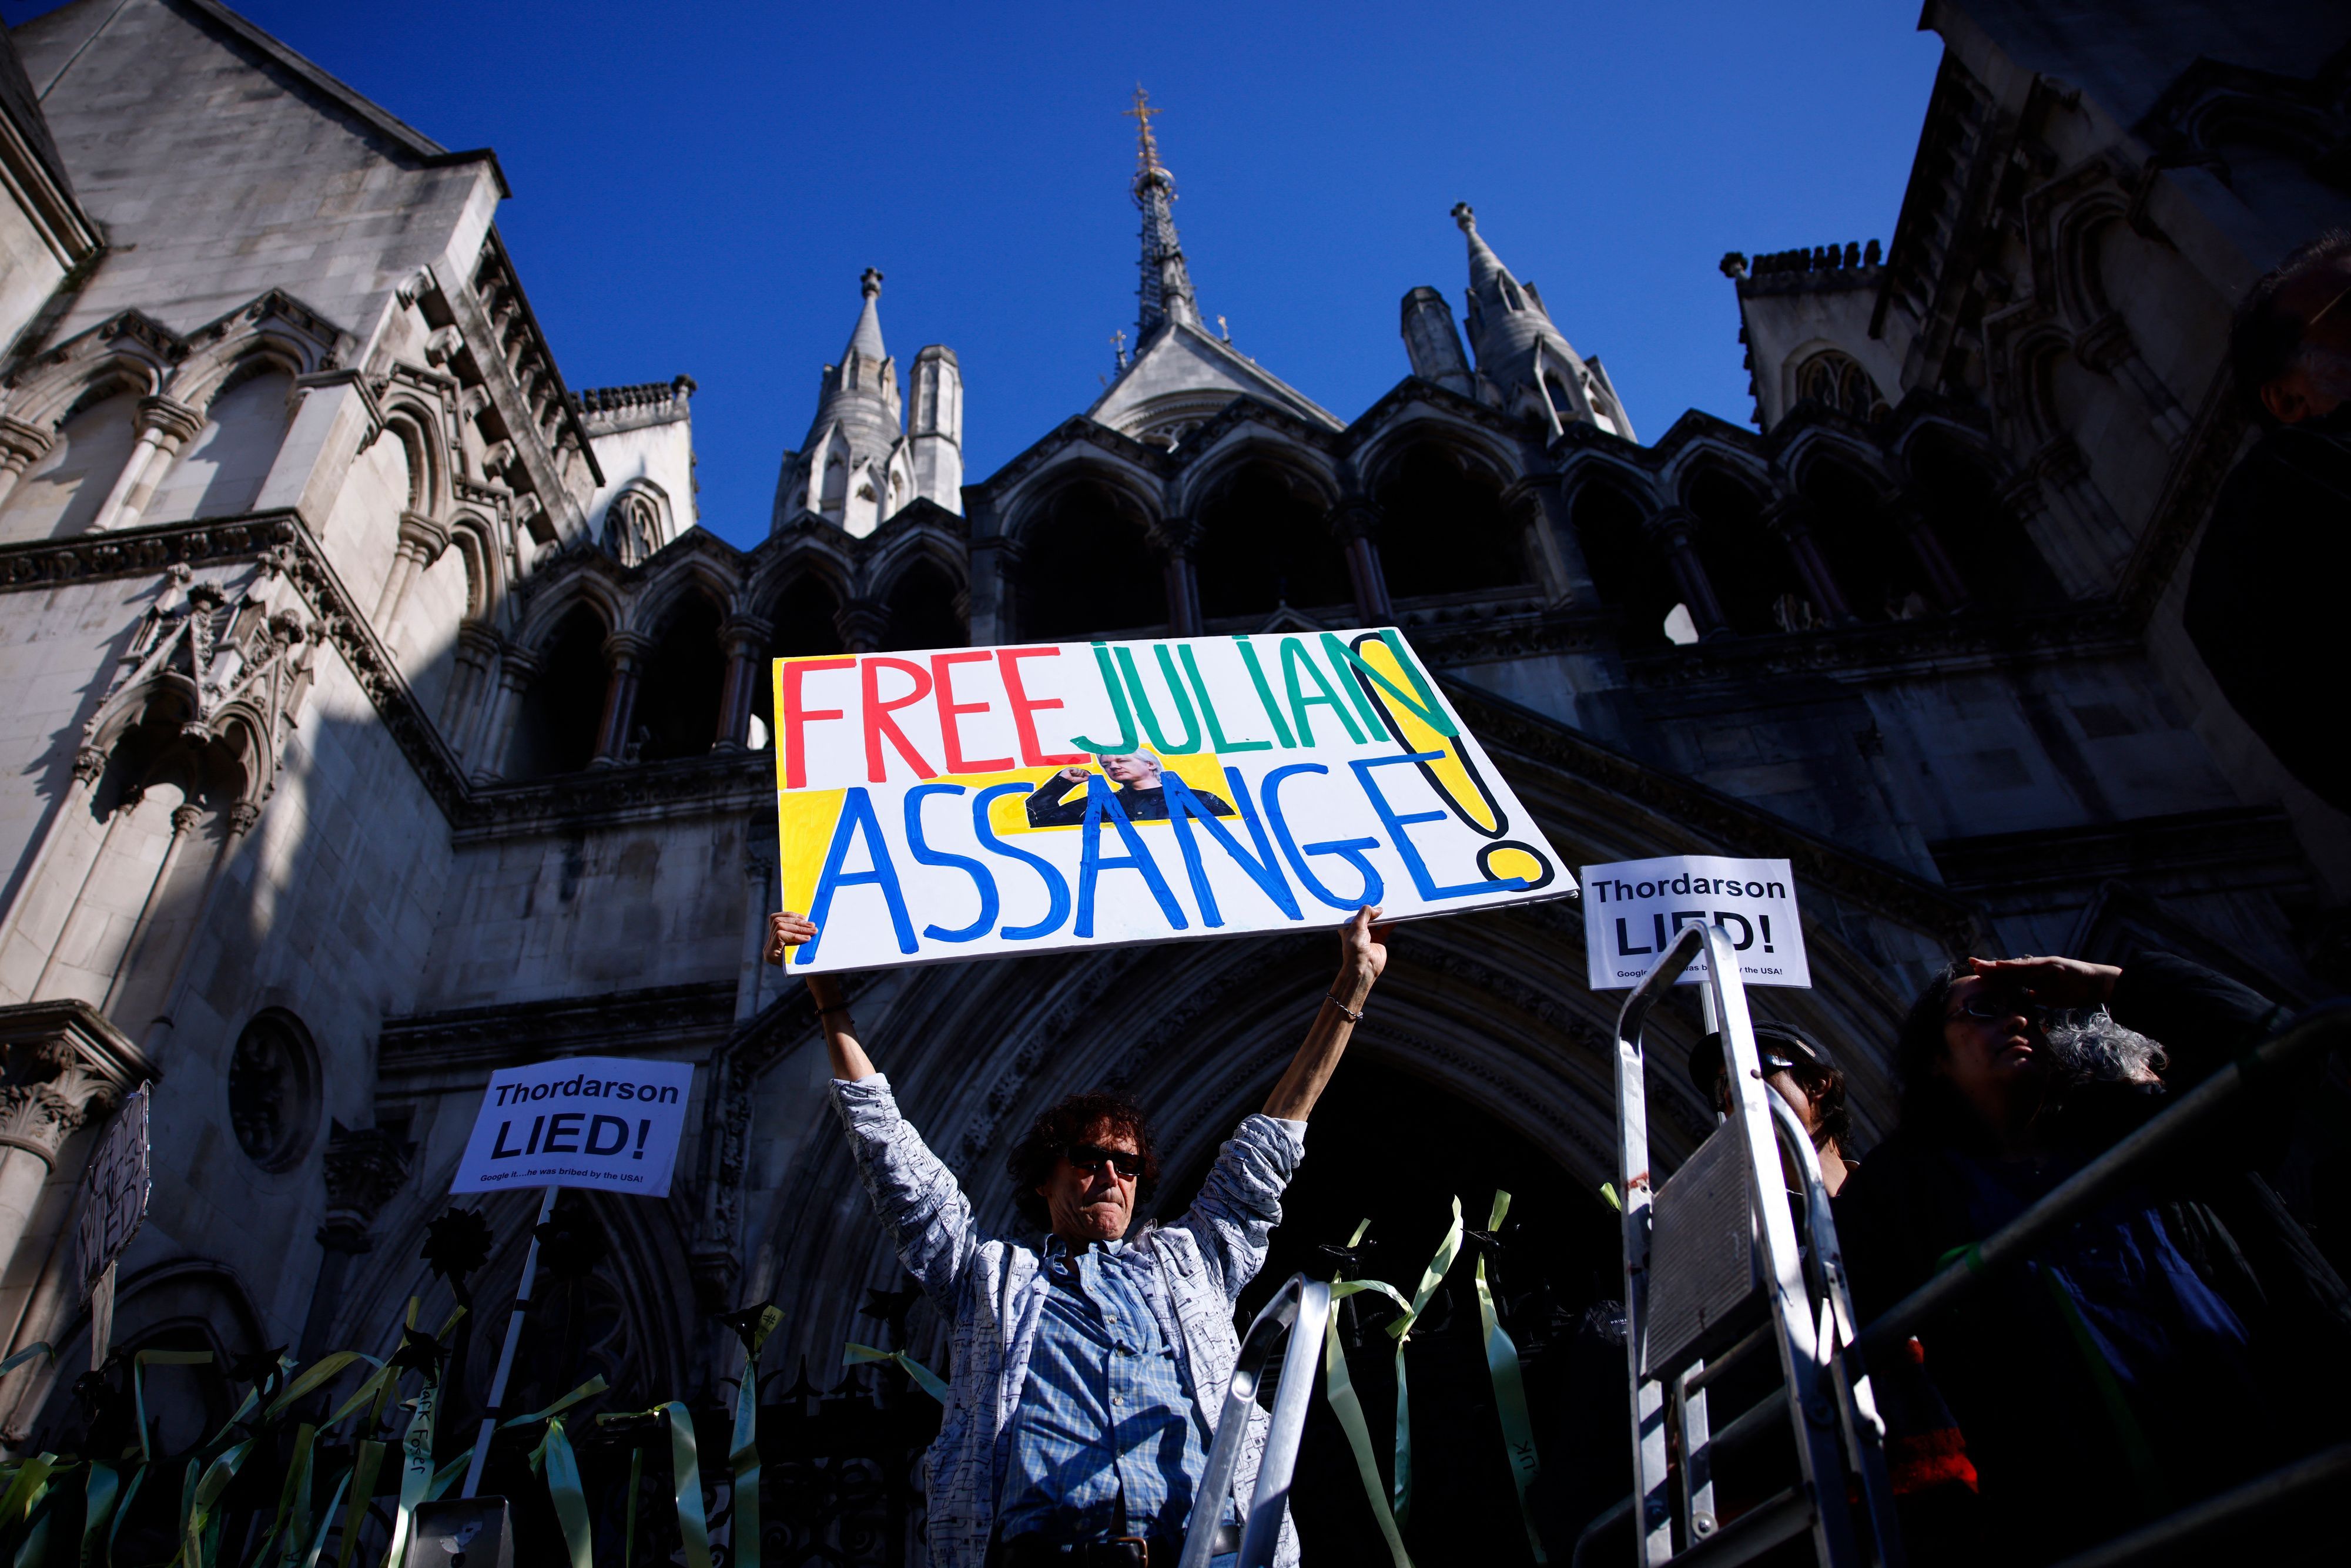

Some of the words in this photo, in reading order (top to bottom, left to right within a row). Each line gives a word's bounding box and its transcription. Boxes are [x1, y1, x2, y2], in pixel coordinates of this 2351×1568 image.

[785, 646, 1091, 789] FREE
[1592, 873, 1786, 902] Thordarson
[496, 1074, 678, 1107] Thordarson
[491, 1113, 651, 1160] LIED!
[481, 1172, 509, 1181] Google
[559, 1168, 588, 1176] bribed
[590, 1170, 601, 1178] by
[621, 1174, 643, 1182] USA!
